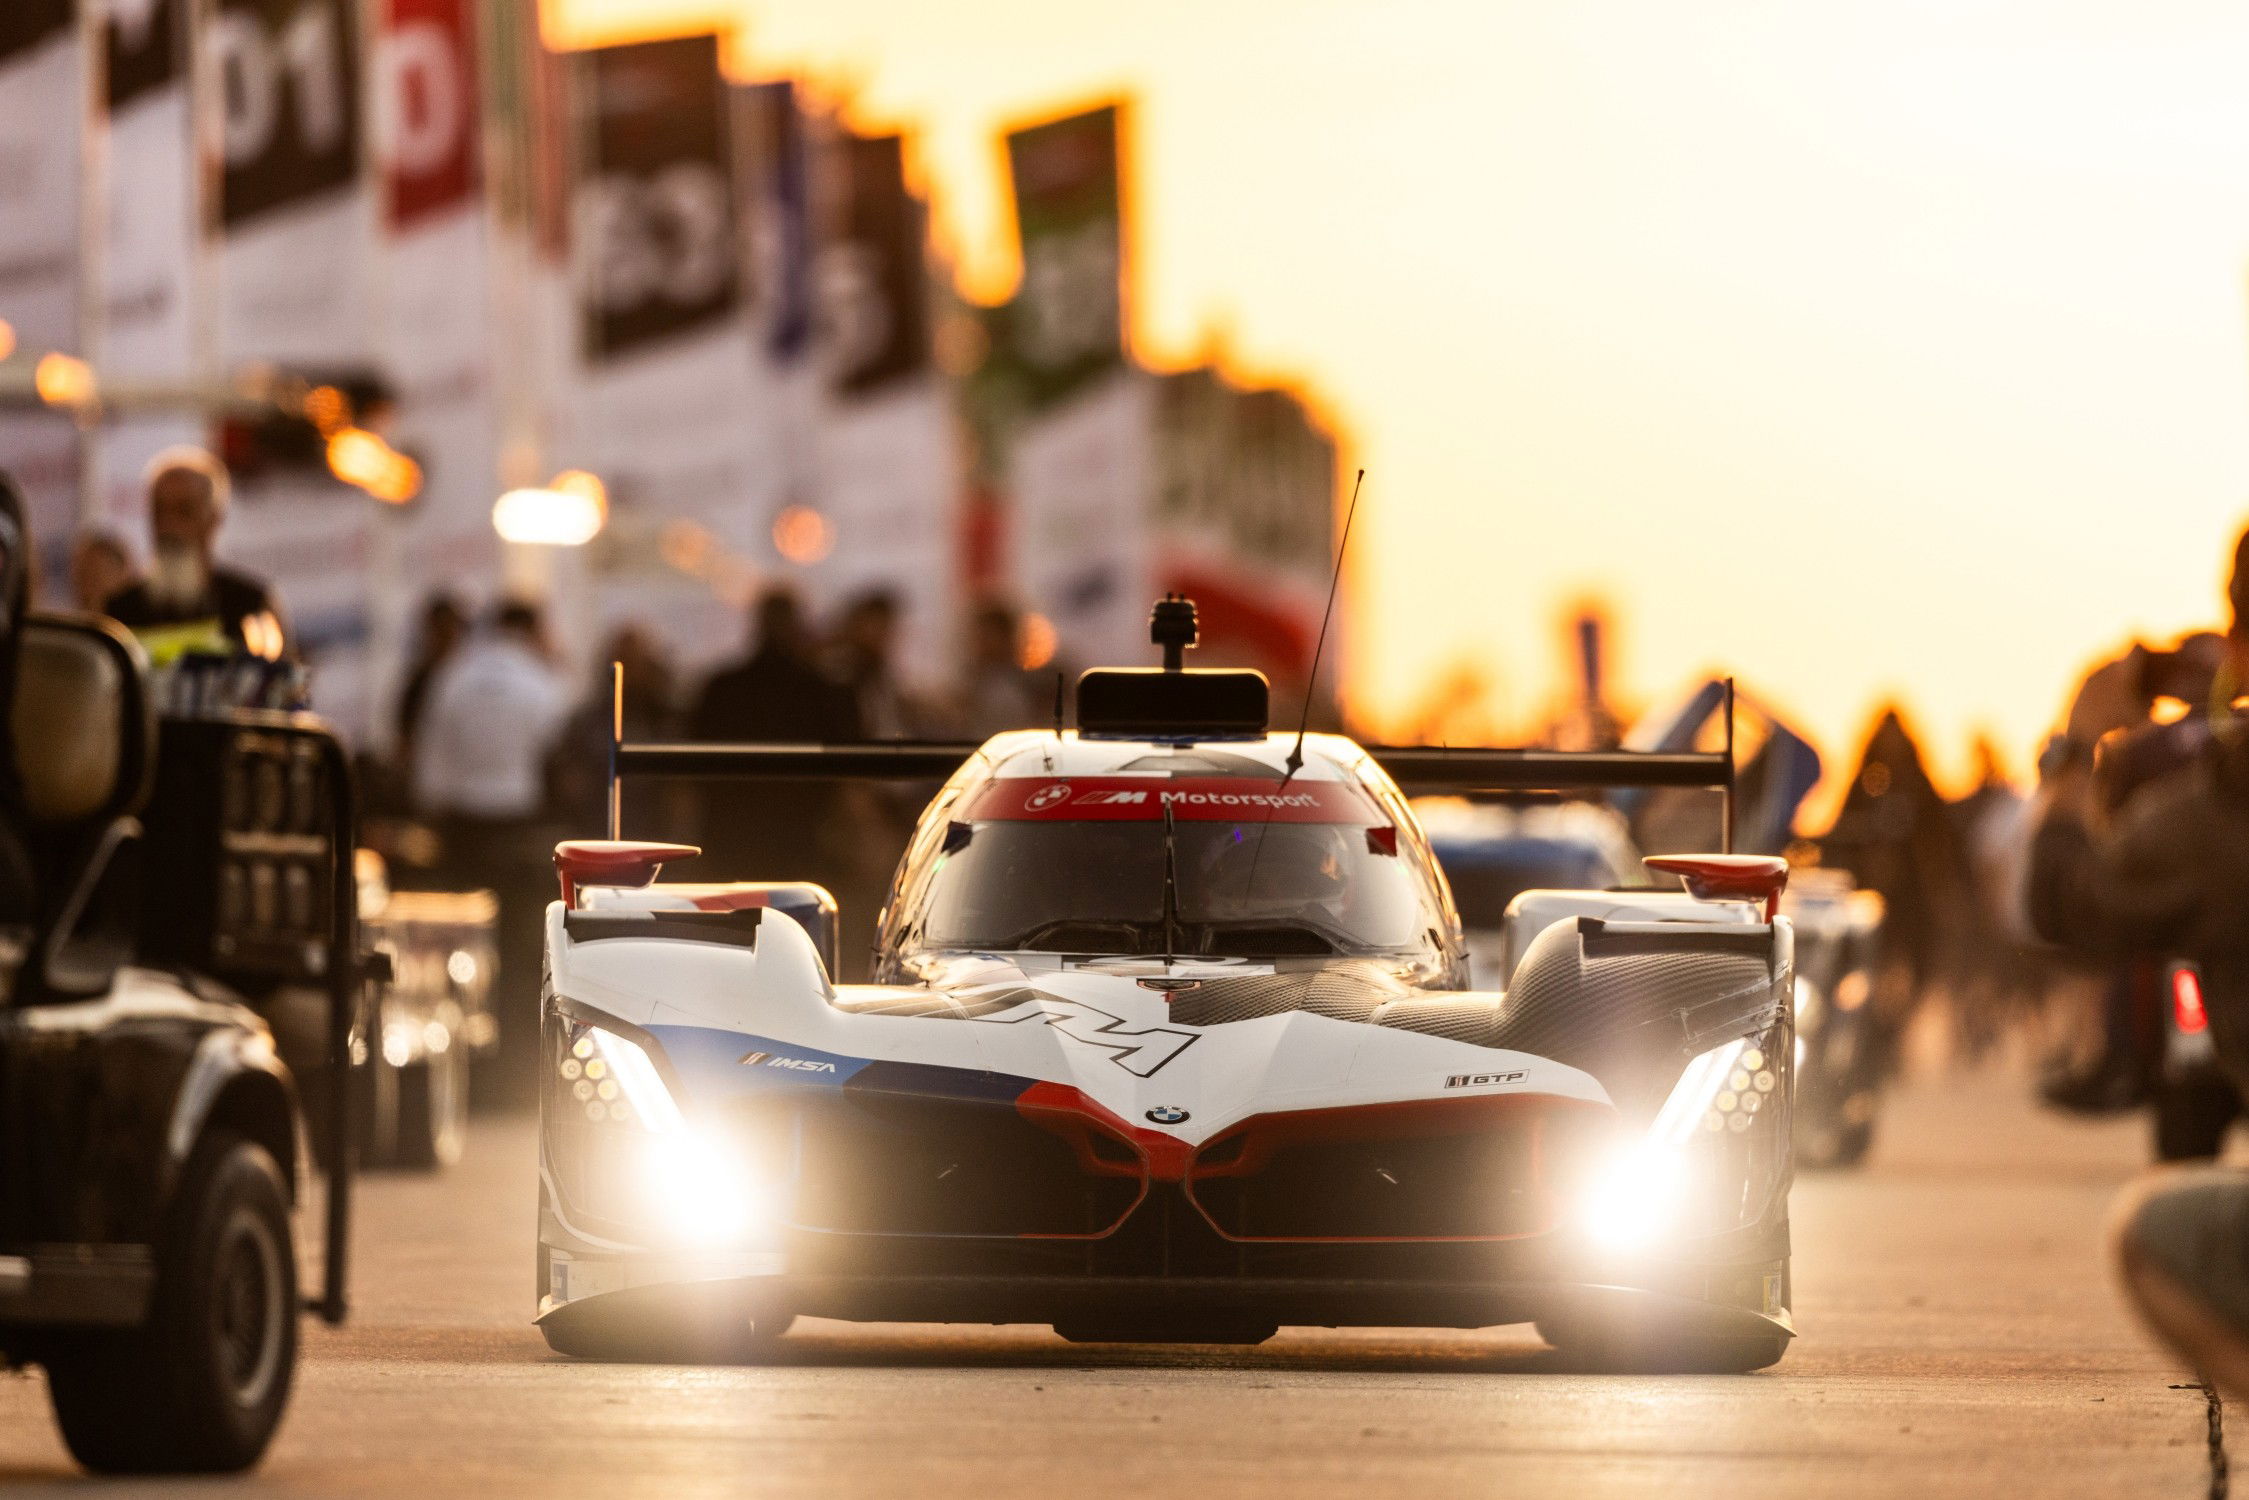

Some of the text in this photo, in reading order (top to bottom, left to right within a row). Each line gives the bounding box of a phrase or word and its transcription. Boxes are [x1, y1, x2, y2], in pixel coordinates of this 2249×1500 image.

[1159, 791, 1321, 809] Motorsport
[767, 1057, 835, 1073] IMSA
[1473, 1072, 1523, 1084] GTP
